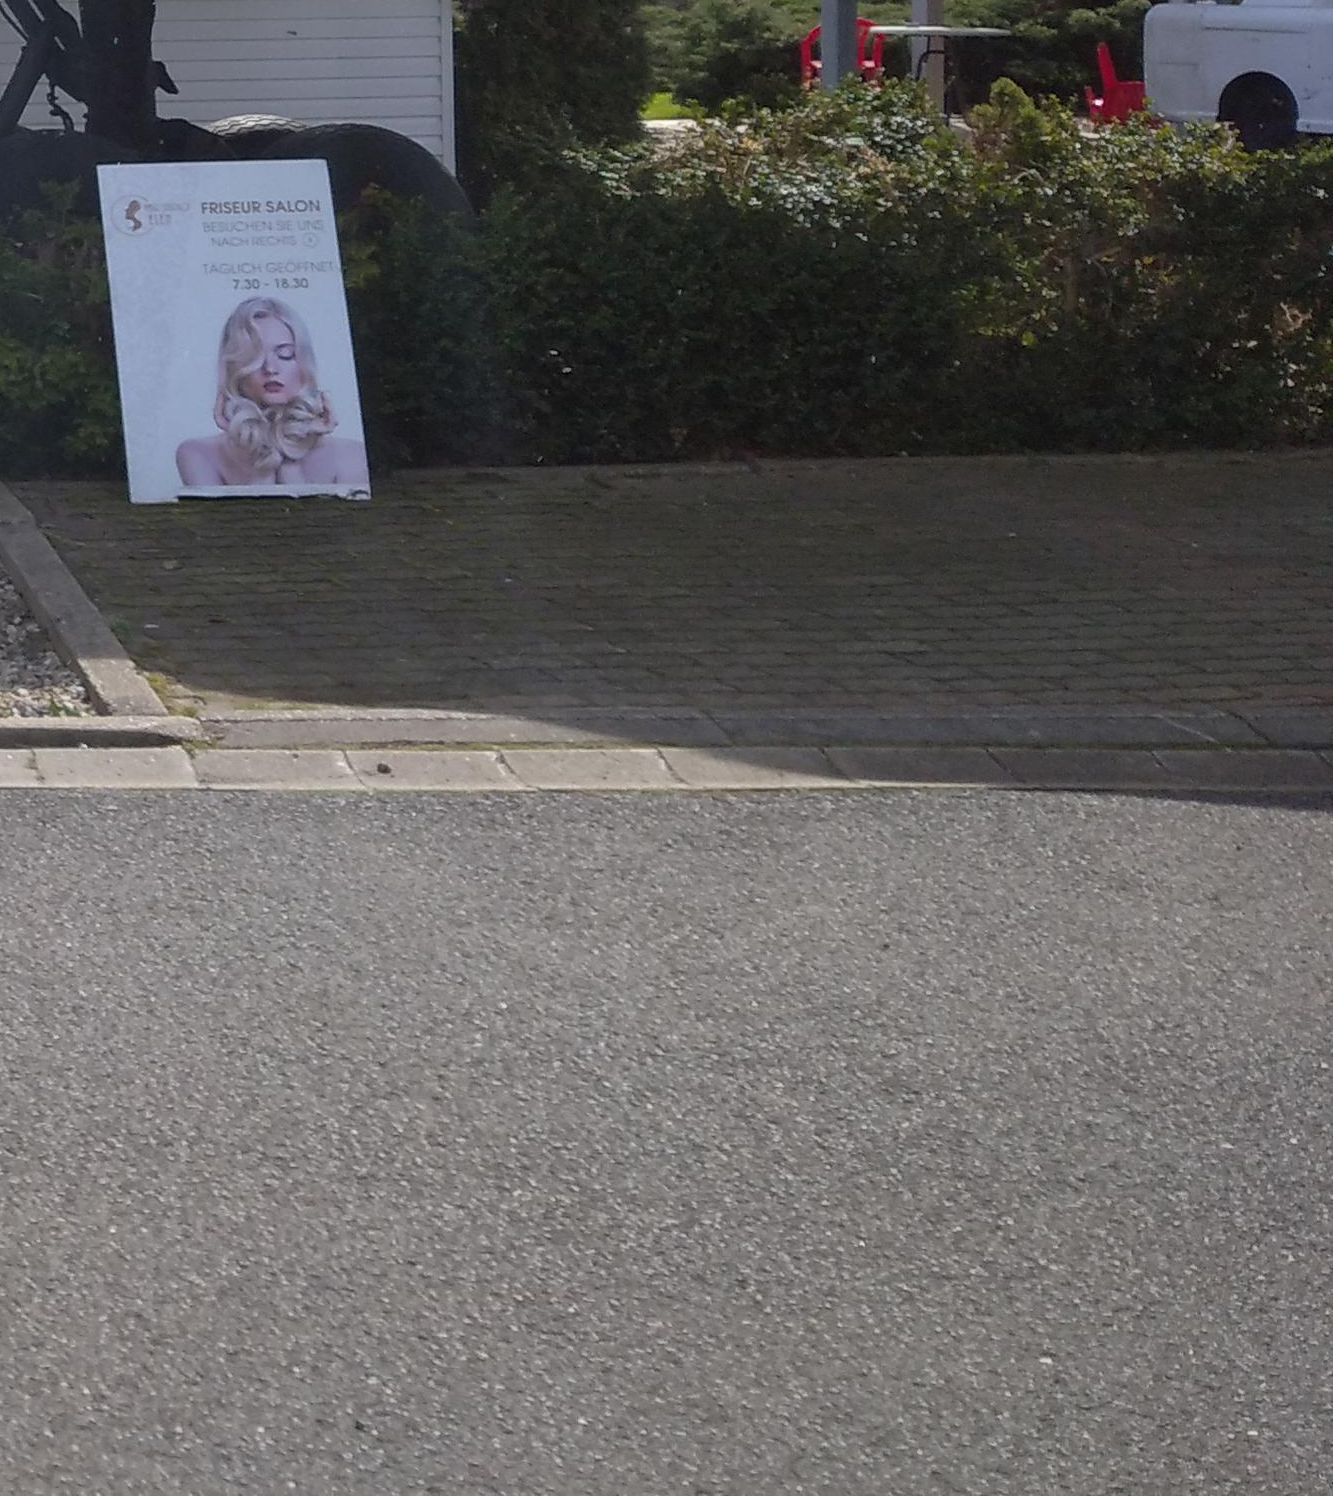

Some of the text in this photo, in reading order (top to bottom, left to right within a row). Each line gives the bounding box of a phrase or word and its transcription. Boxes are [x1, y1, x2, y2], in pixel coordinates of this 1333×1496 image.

[201, 201, 261, 214] FRISEUR
[266, 200, 320, 213] SALON
[203, 219, 324, 232] BESUCHEN SIE UNS
[211, 235, 296, 247] NACH RECHTS
[232, 278, 261, 290] 7.30
